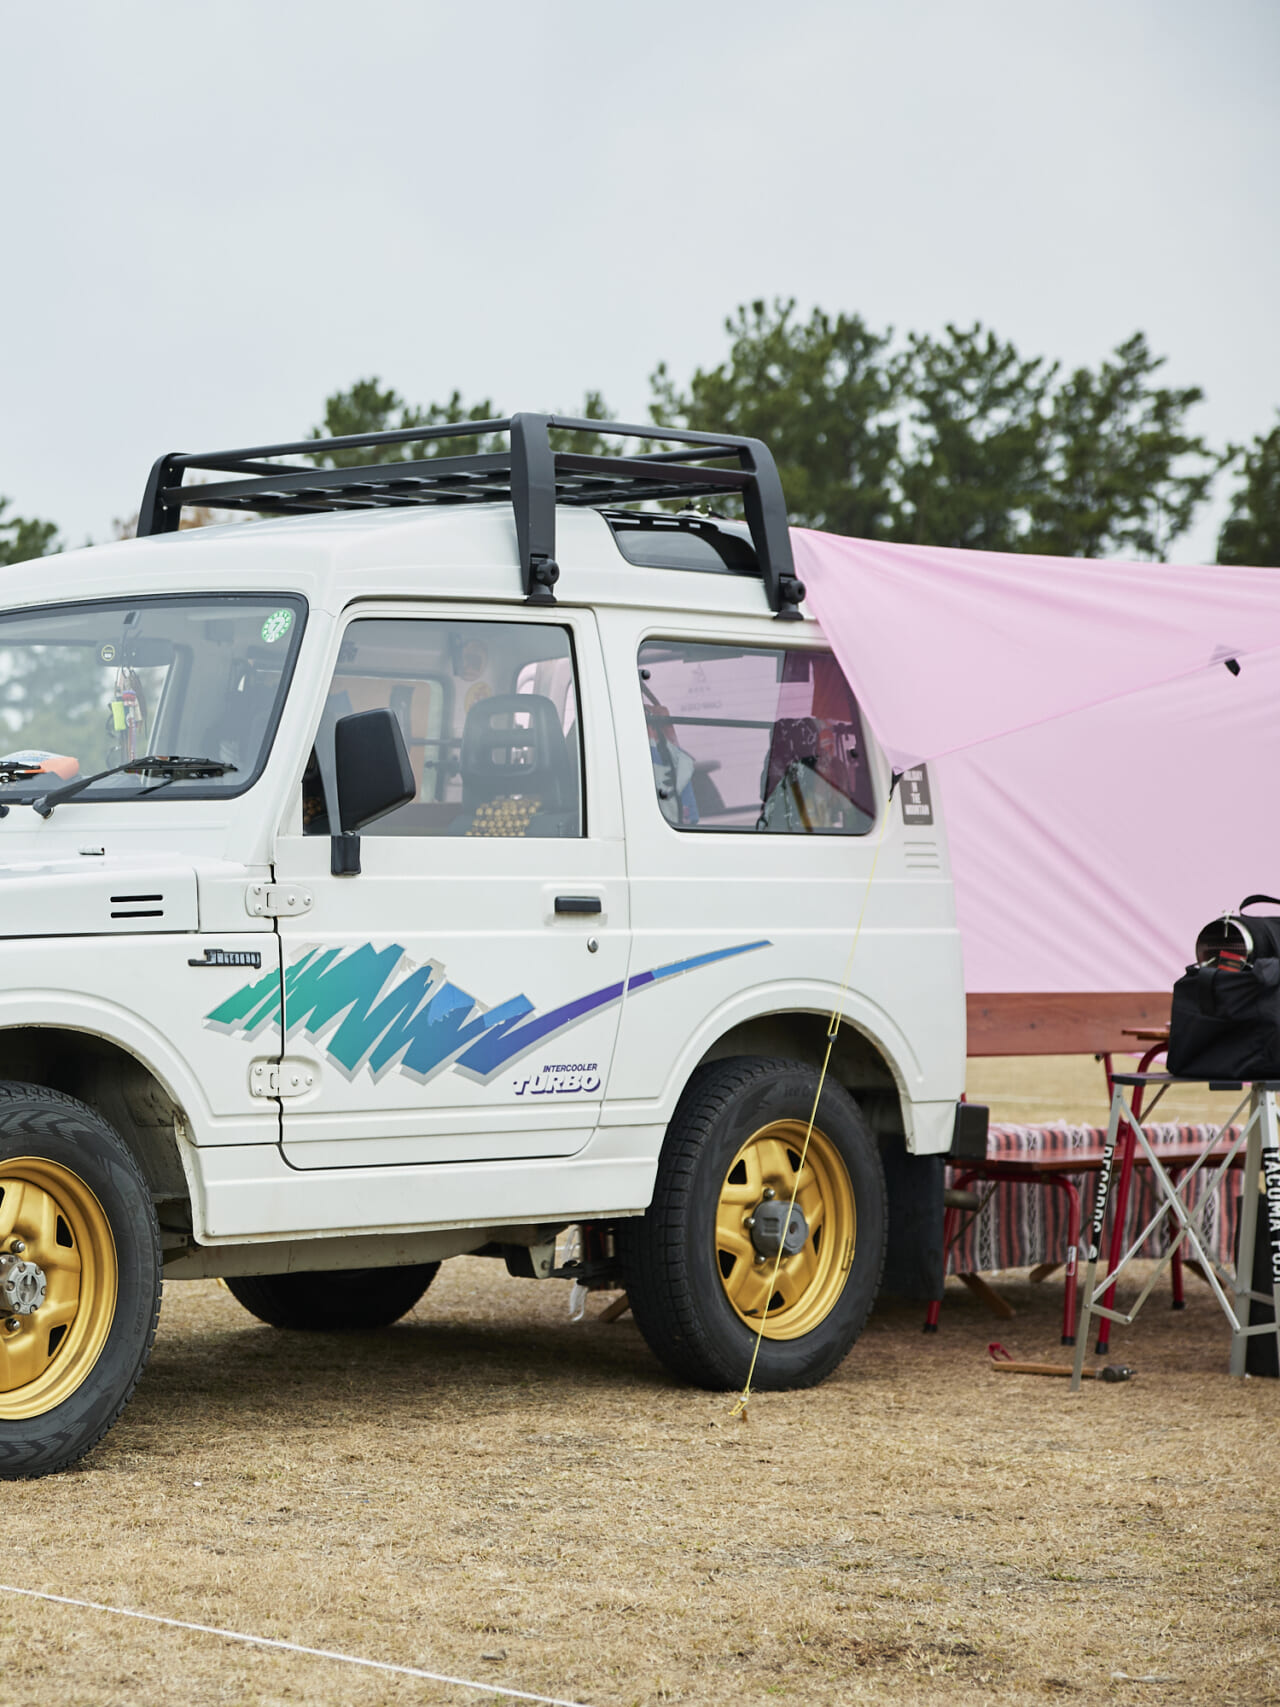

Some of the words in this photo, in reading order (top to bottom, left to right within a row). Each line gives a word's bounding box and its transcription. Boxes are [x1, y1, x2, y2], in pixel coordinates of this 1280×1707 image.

[542, 1063, 598, 1073] INTERCOOLER
[513, 1075, 601, 1096] TURBO
[1263, 1150, 1280, 1233] TACOMA
